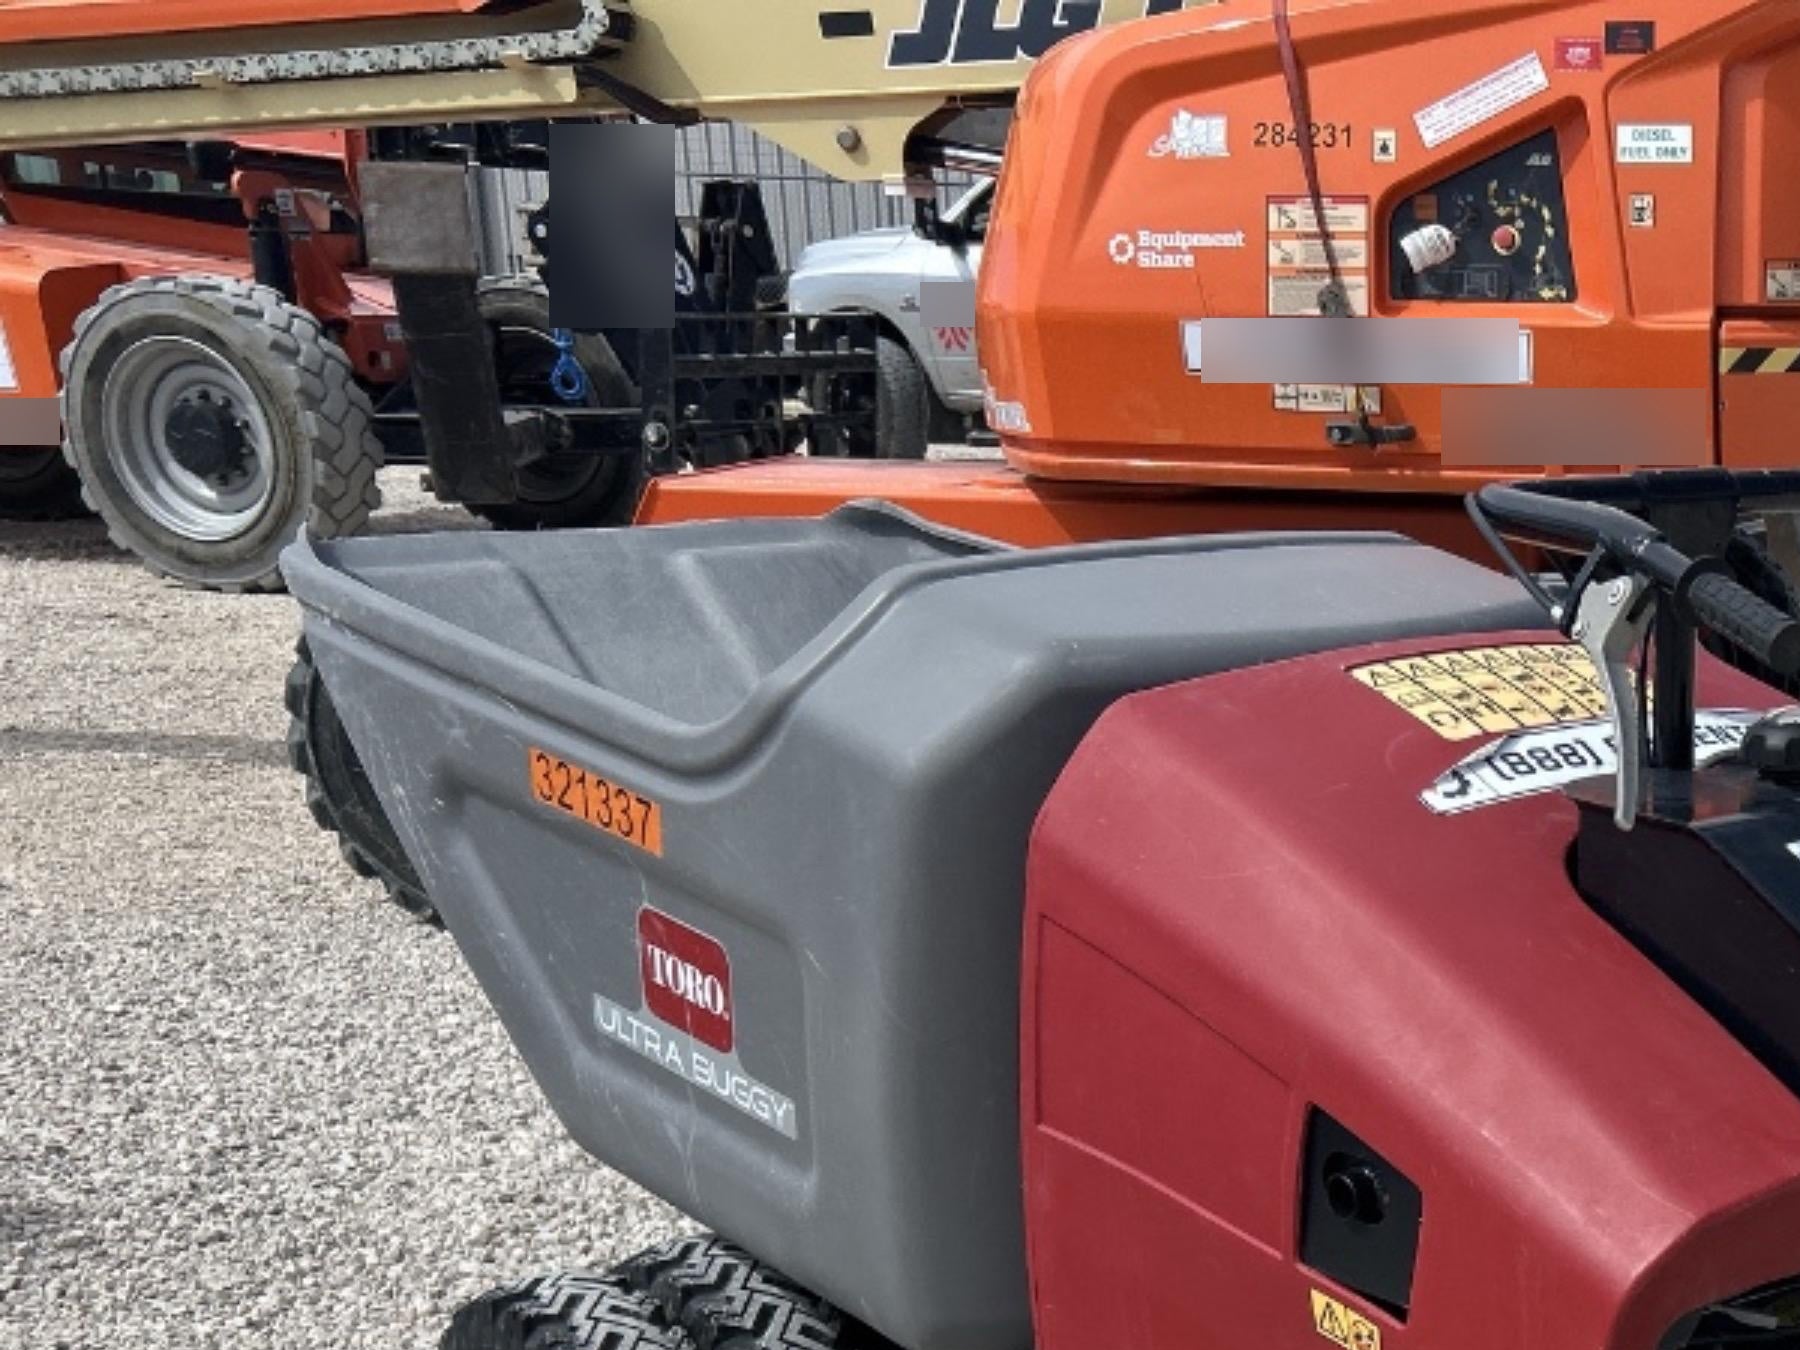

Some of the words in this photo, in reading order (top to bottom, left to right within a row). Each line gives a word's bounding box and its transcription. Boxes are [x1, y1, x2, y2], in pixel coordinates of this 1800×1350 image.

[1253, 122, 1352, 149] 284231
[1631, 127, 1677, 142] DIESEL
[1136, 230, 1246, 252] Equipment
[1136, 251, 1195, 268] Share
[536, 752, 652, 847] 321337
[647, 944, 726, 1016] TORO
[600, 1007, 685, 1073] ULTRA
[692, 1050, 789, 1129] BUGGY
